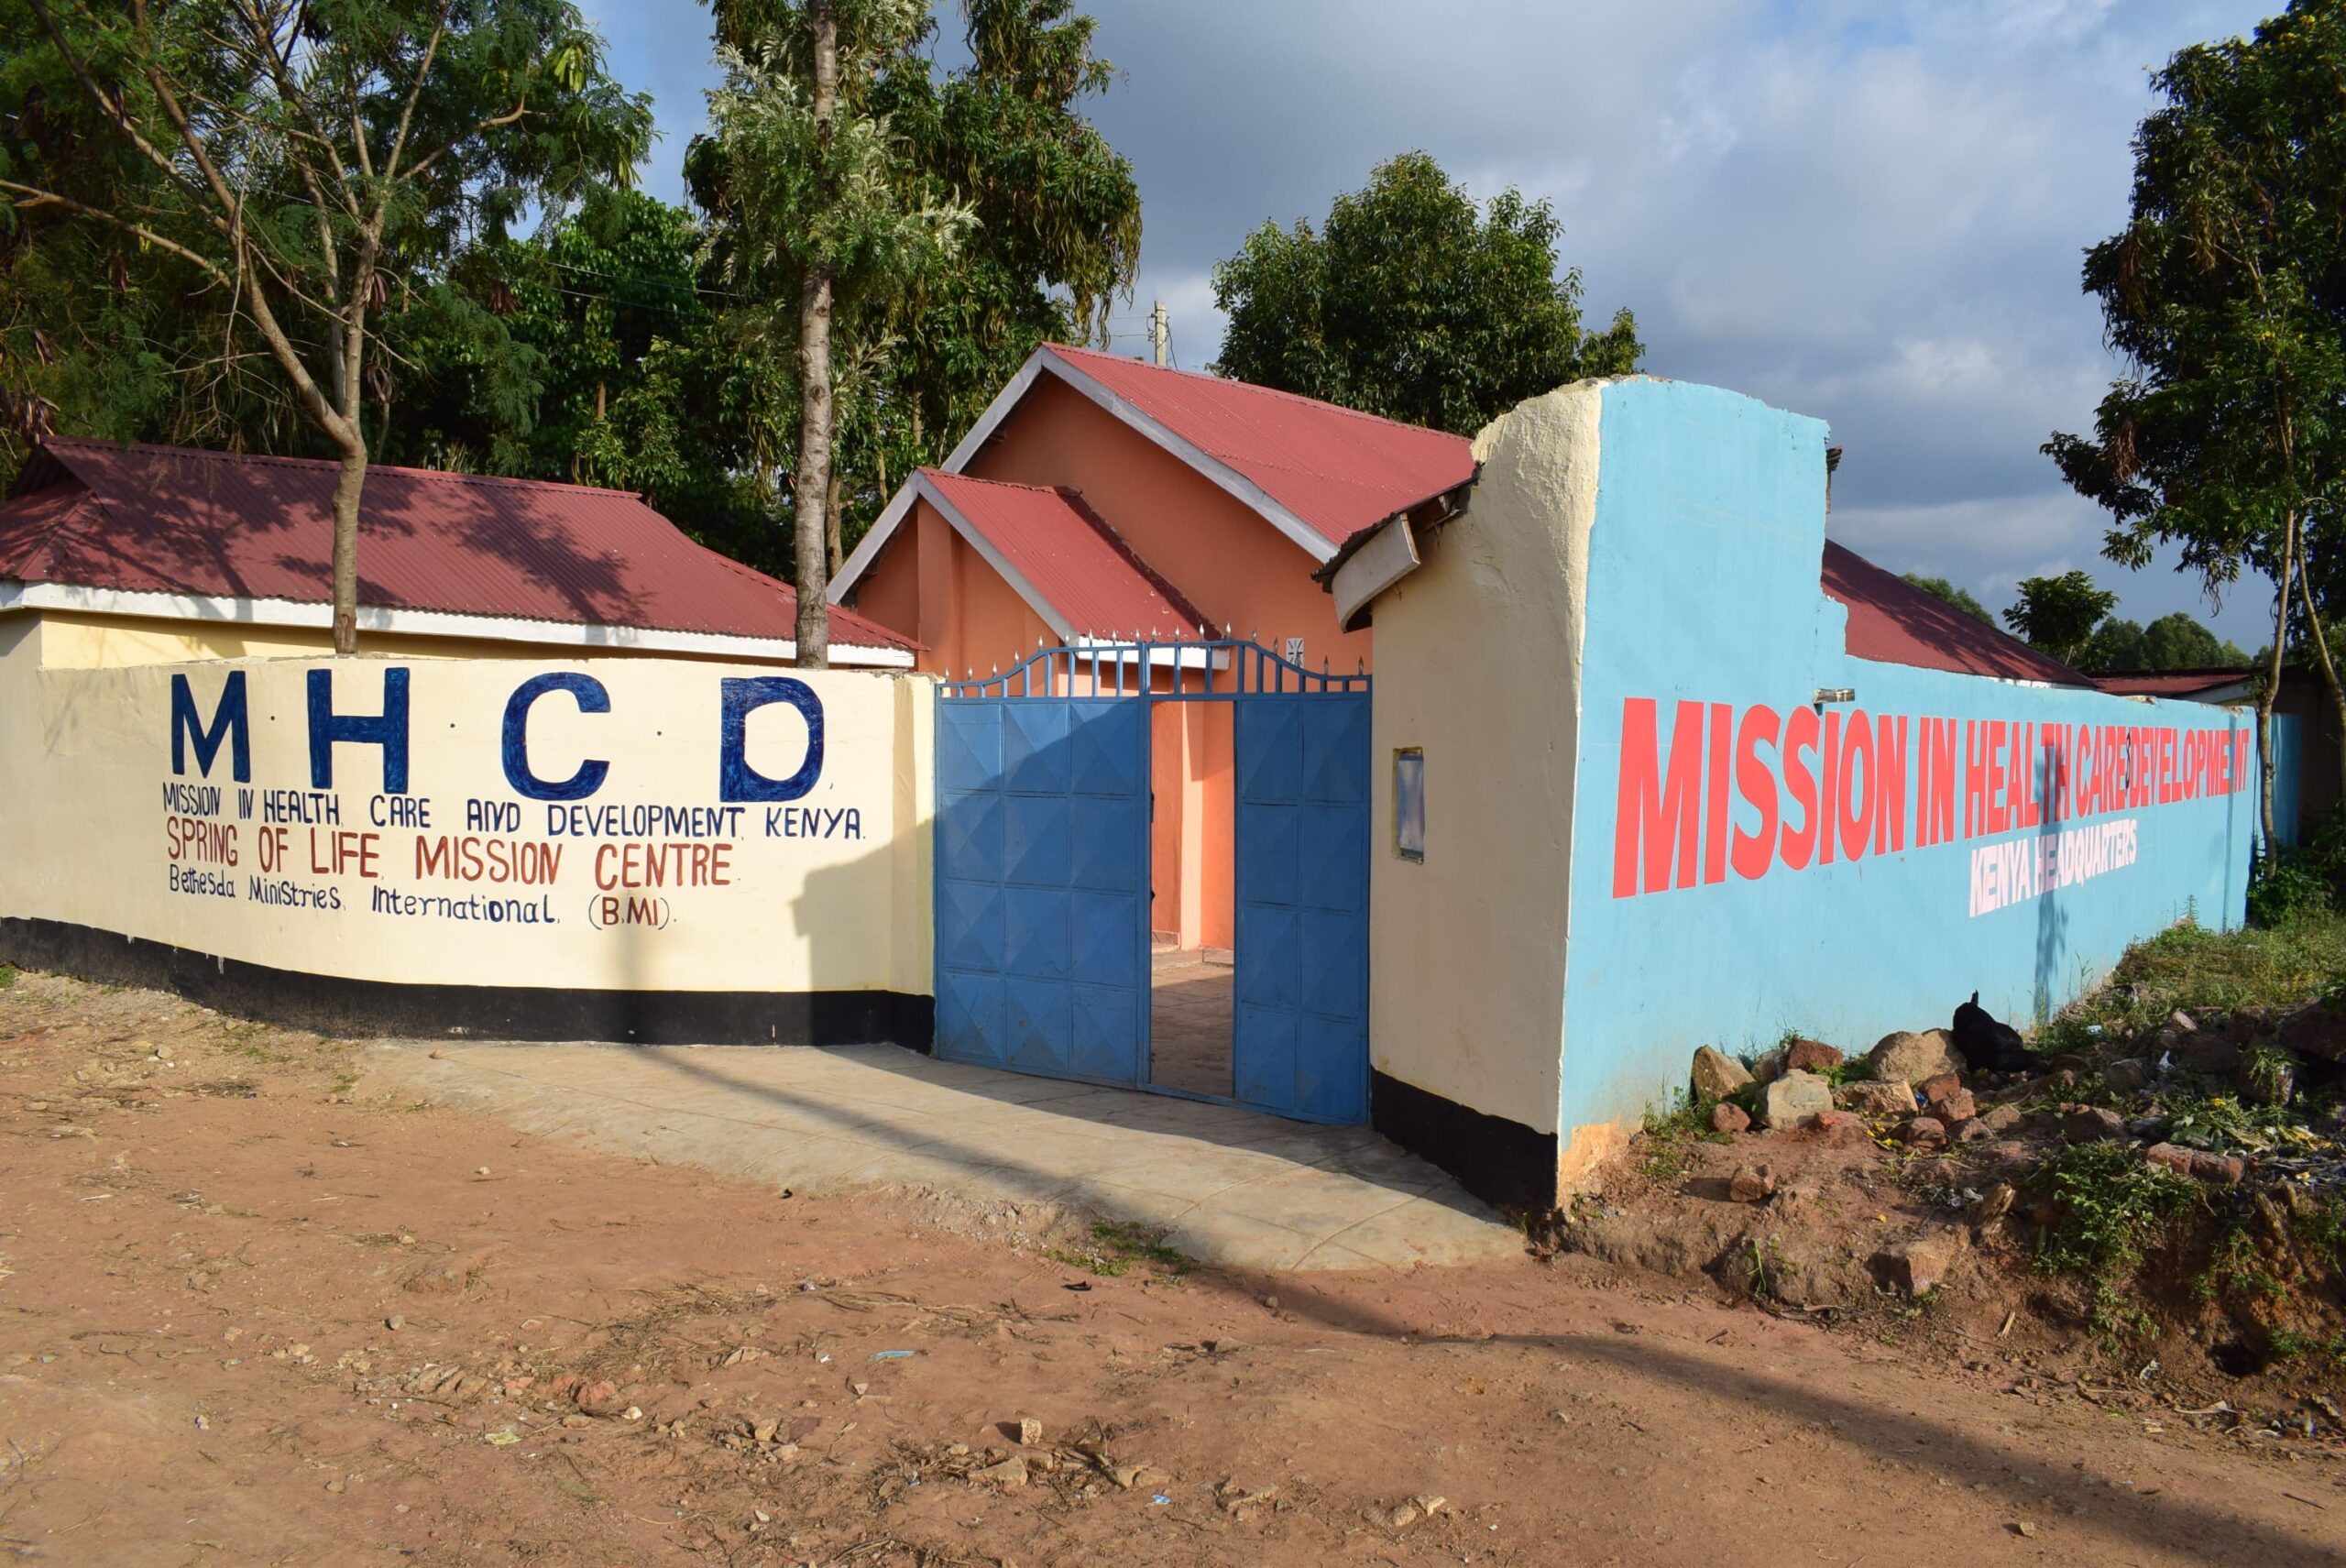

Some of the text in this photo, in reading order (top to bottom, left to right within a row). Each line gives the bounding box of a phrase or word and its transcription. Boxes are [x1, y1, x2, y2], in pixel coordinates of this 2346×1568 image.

[163, 782, 222, 817] MISSION
[238, 788, 255, 819] IN
[370, 795, 432, 828] CARE
[466, 798, 521, 833] AND
[1613, 696, 1908, 899] MISSION
[1916, 716, 1957, 849] IN
[1964, 719, 2072, 839] HEALTH
[2076, 723, 2127, 818] CARE
[2129, 727, 2250, 808] DEVELOPMENT
[167, 816, 238, 866] SPRING
[258, 826, 289, 872] OF
[415, 835, 563, 885] MISSION
[1969, 818, 2137, 918] KENYA HEADQUARTERS
